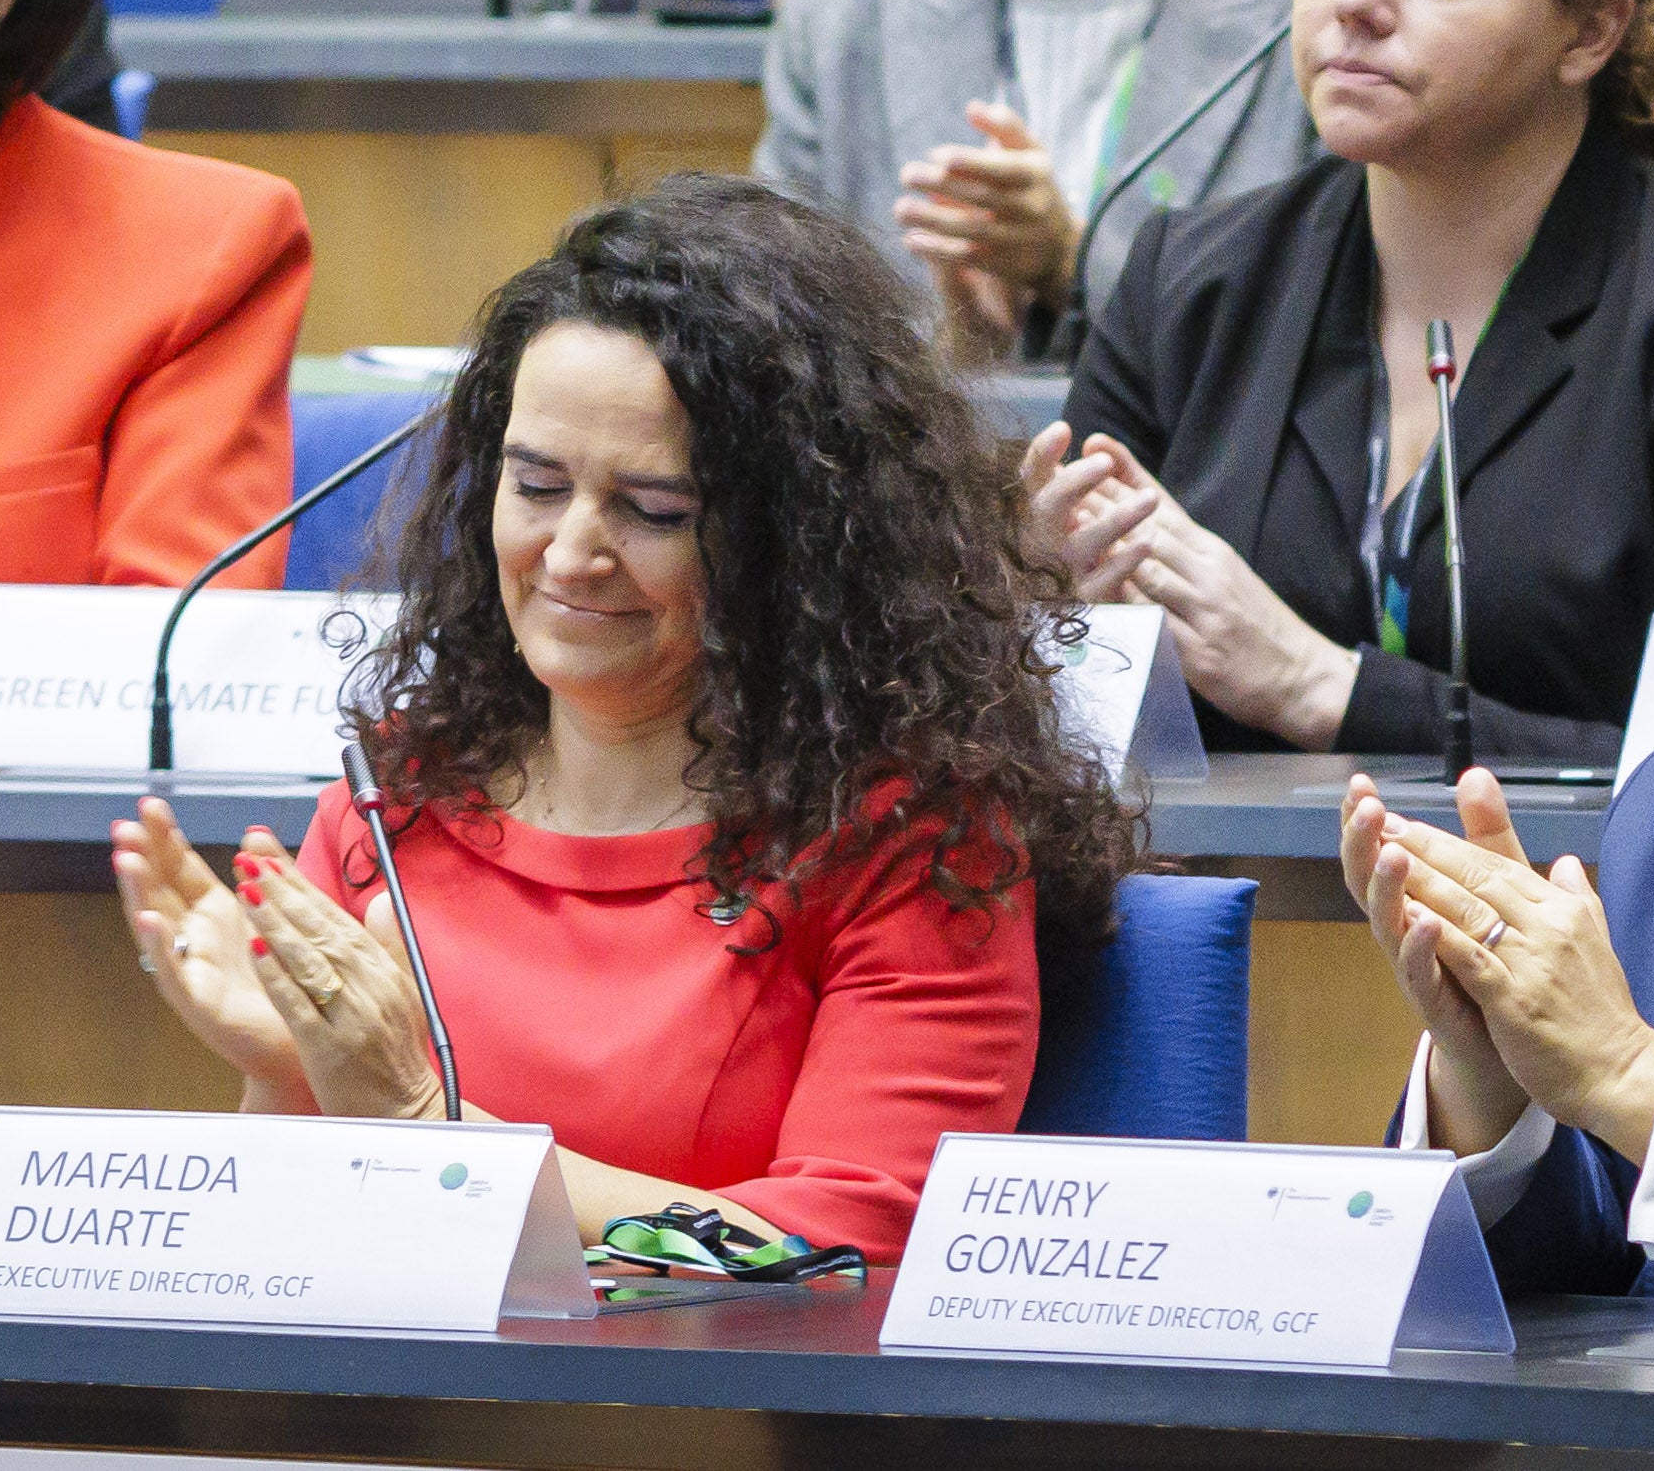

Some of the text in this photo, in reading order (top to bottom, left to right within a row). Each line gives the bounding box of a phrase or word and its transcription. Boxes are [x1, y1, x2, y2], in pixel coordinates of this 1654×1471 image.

[118, 679, 283, 716] CLMATE
[20, 1150, 238, 1194] MAFALDA
[962, 1176, 1110, 1219] HENRY
[4, 1205, 191, 1249] DUARTE
[945, 1233, 1170, 1282] GONZALEZ
[129, 1270, 254, 1300] DIRECTOR,
[264, 1275, 314, 1298] GCF
[927, 1295, 1319, 1336] DEPUTY EXECUTIVE DIRECTOR, GCF
